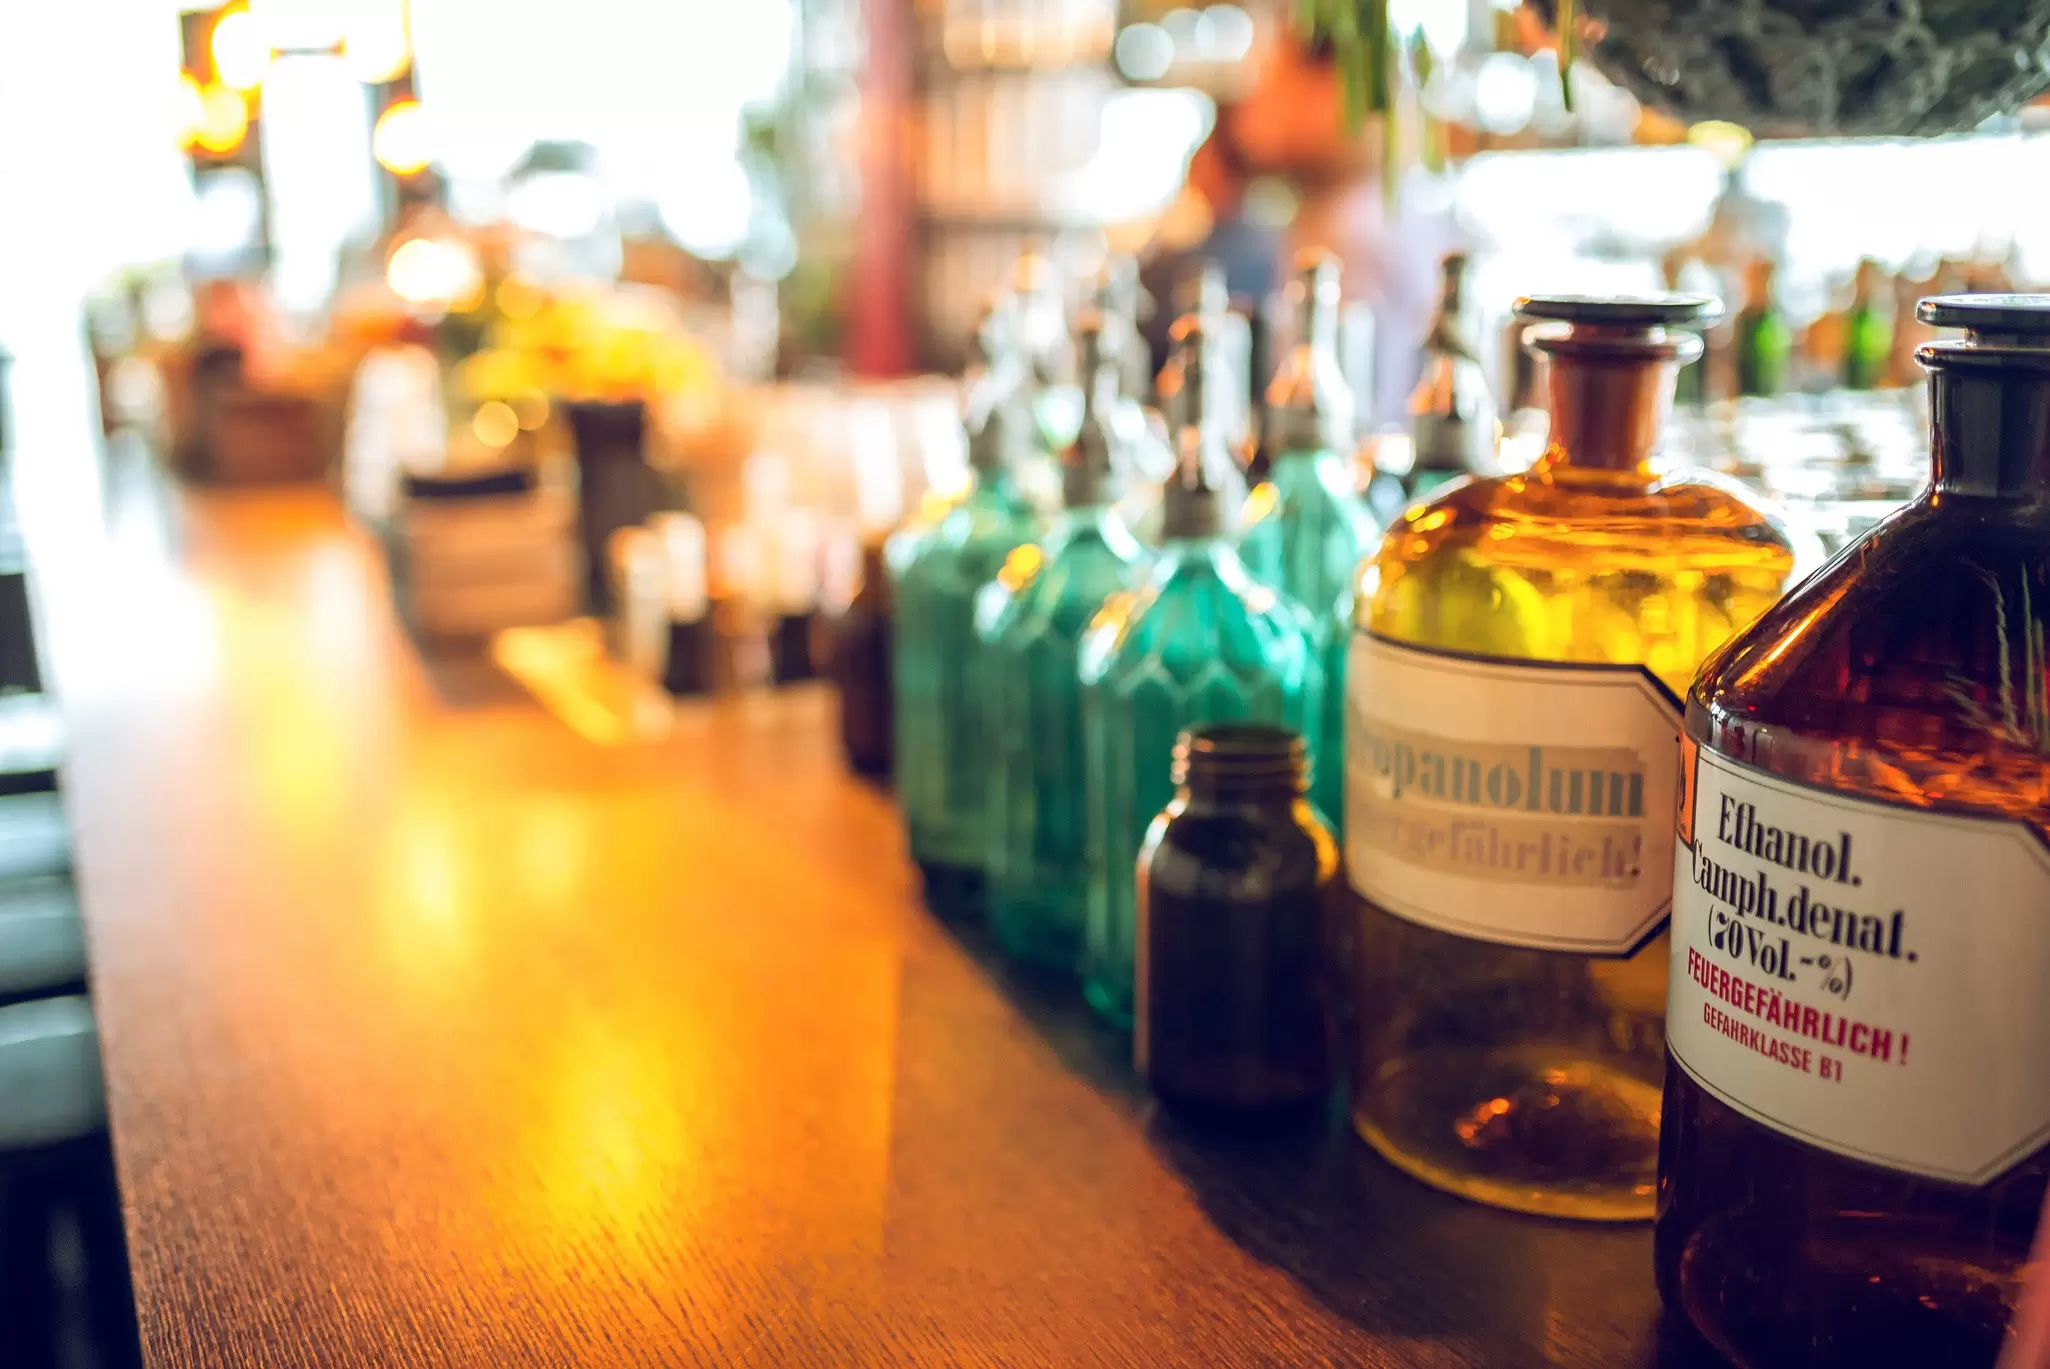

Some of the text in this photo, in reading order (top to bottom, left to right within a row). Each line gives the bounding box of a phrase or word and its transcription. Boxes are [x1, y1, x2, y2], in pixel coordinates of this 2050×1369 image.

[1717, 791, 1862, 887] Ethanol.
[1703, 1002, 1844, 1084] GEFAHRKLASSE B1
